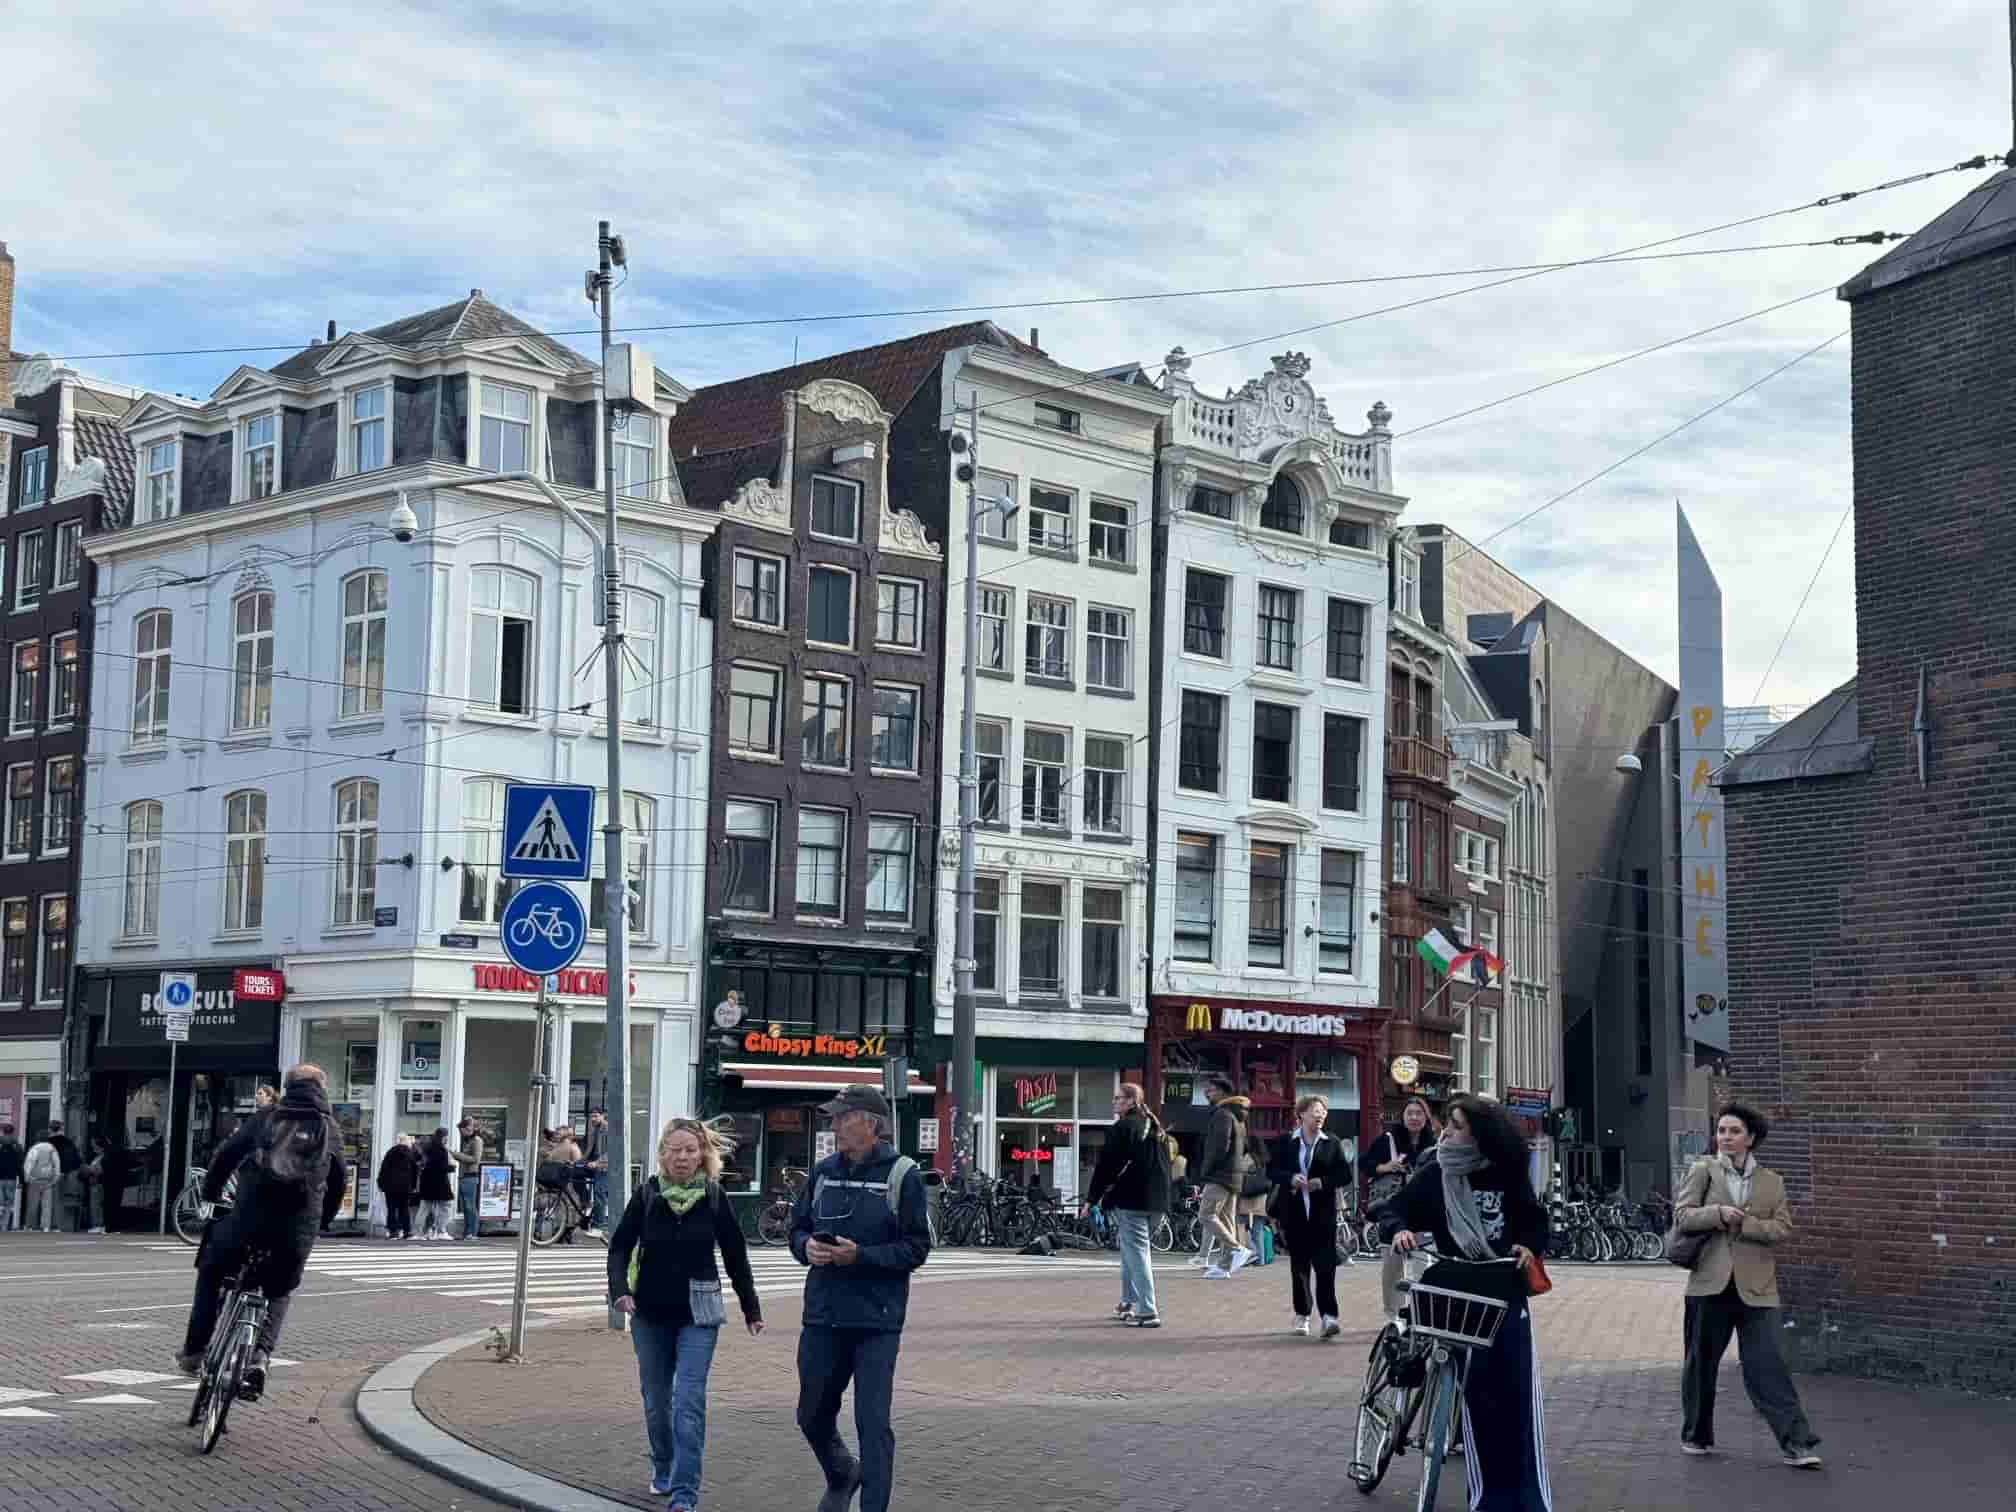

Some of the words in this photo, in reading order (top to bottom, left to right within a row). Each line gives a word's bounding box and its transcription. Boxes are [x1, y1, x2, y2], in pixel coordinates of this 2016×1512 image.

[1284, 394, 1294, 414] 9
[1220, 1007, 1345, 1037] McDonald's
[744, 1031, 813, 1057] Chipsy
[814, 1034, 858, 1060] King
[857, 1034, 888, 1057] XL
